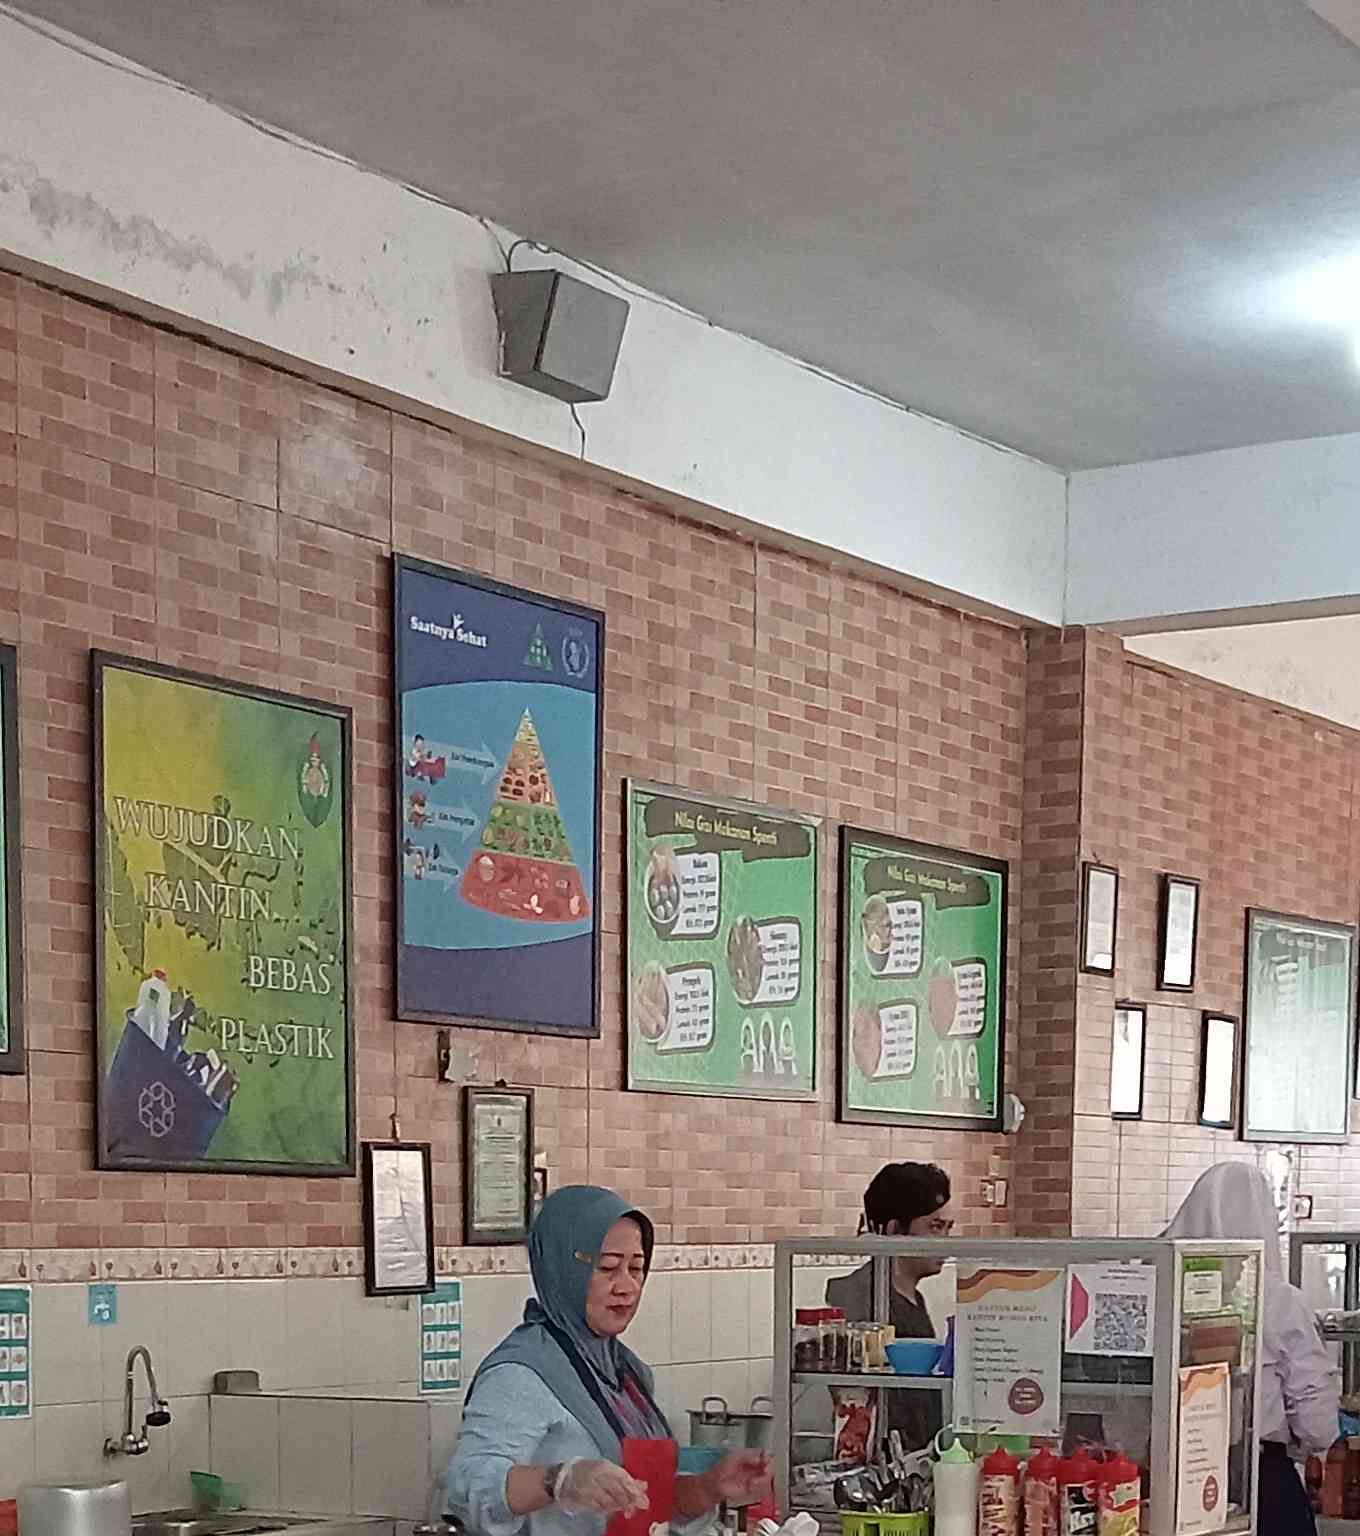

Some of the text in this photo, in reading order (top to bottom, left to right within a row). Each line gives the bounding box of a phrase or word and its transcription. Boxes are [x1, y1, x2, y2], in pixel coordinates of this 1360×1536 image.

[410, 615, 487, 648] Saatnya Sehat
[113, 797, 301, 860] WUJUDKAN
[144, 871, 271, 921] KANTIN
[248, 954, 331, 995] BEBAS
[220, 1017, 334, 1059] PLASTIK
